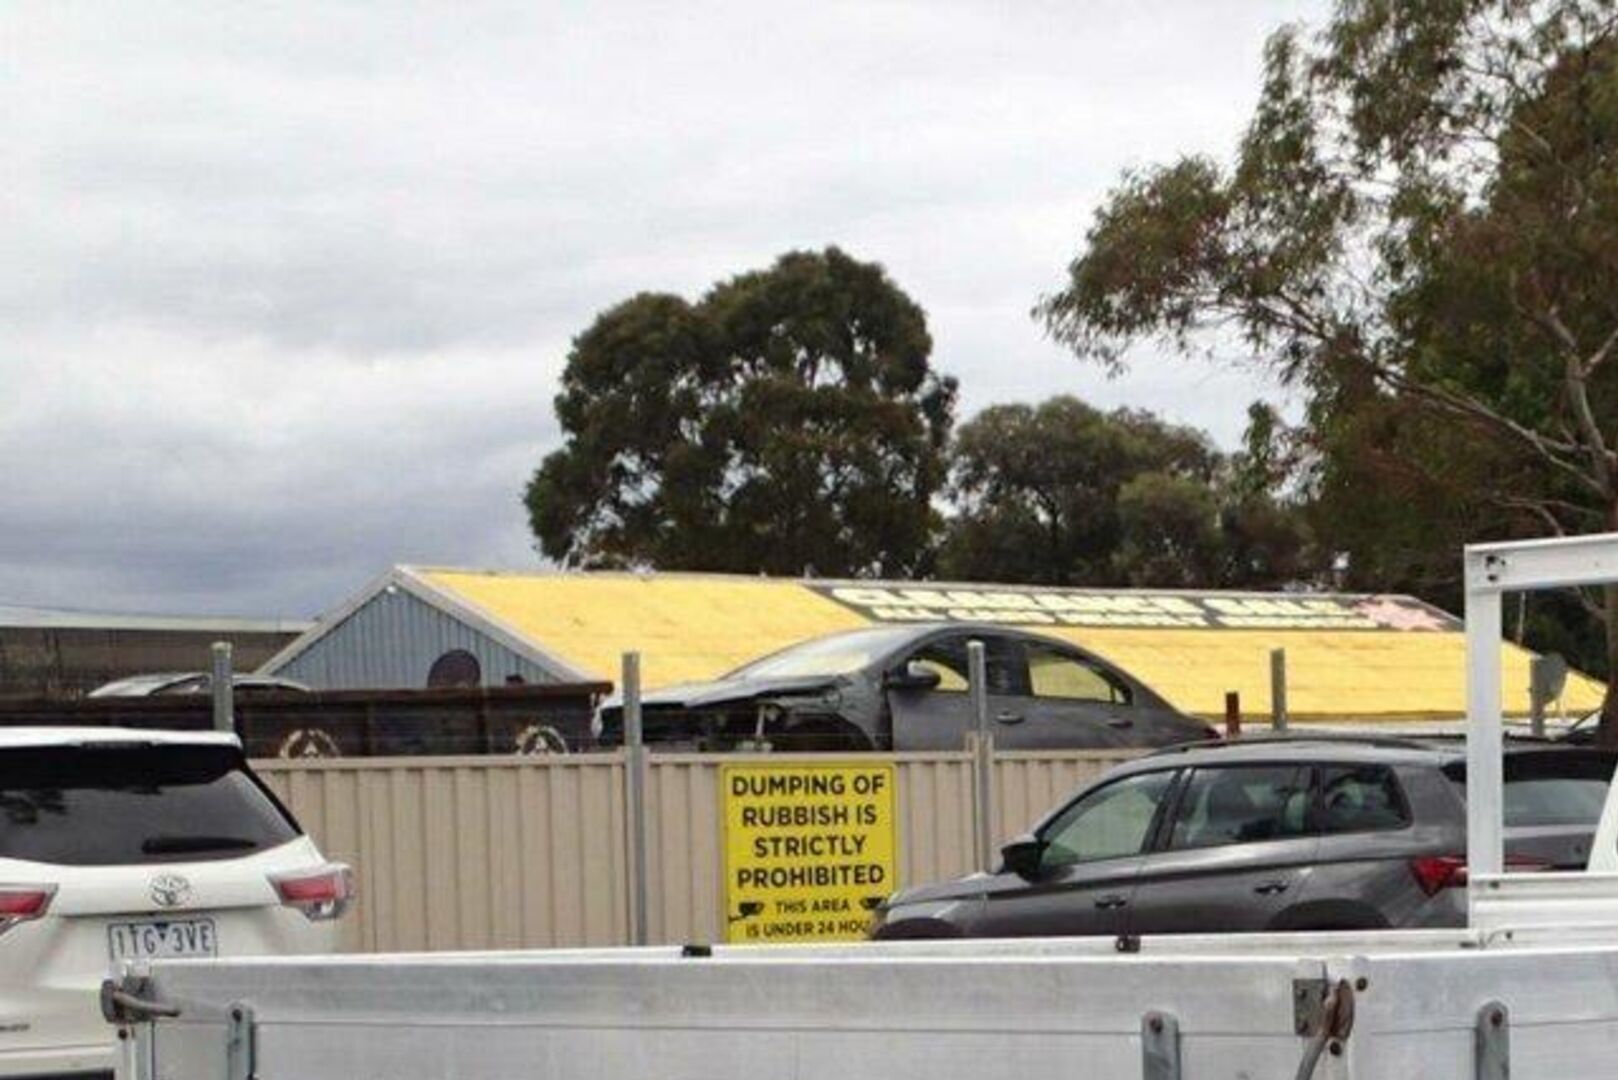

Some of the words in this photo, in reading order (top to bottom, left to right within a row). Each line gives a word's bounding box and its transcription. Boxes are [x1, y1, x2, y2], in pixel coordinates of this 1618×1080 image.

[732, 775, 845, 796] DUMPING
[853, 774, 885, 796] OF
[742, 806, 848, 827] RUBBISH
[856, 804, 877, 825] IS
[754, 835, 867, 858] STRICTLY
[737, 865, 884, 888] PROHIBITED
[775, 901, 806, 914] THIS
[811, 899, 850, 913] AREA
[746, 923, 759, 937] IS
[763, 921, 815, 937] UNDER
[818, 920, 835, 934] 24
